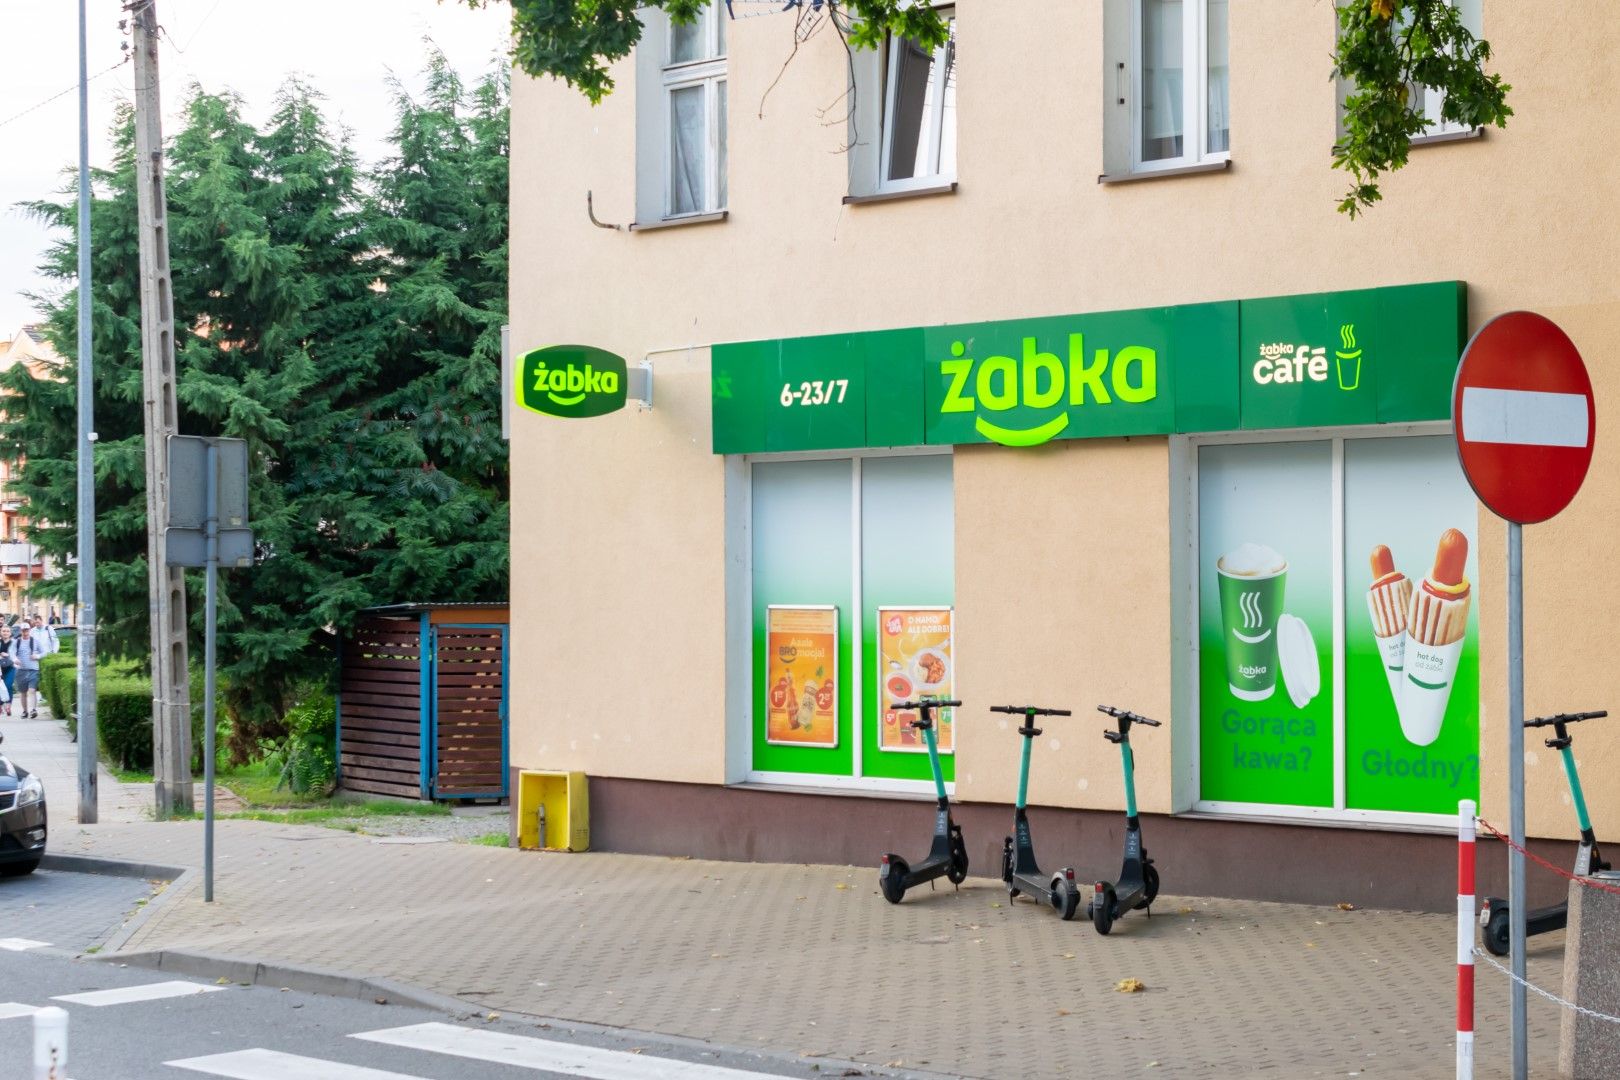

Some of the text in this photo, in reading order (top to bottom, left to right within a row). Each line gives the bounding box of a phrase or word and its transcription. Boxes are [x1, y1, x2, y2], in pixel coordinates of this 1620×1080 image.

[1253, 345, 1328, 384] café
[1260, 342, 1294, 356] żabka
[533, 361, 619, 394] żabka
[940, 332, 1157, 413] żabka
[780, 379, 849, 407] 6-23/7
[1238, 663, 1267, 675] żabka
[1416, 651, 1429, 661] hot
[1430, 654, 1444, 666] dog
[1220, 708, 1317, 744] Gorąca
[1233, 743, 1313, 772] kawa?
[1361, 748, 1480, 789] Głodny?
